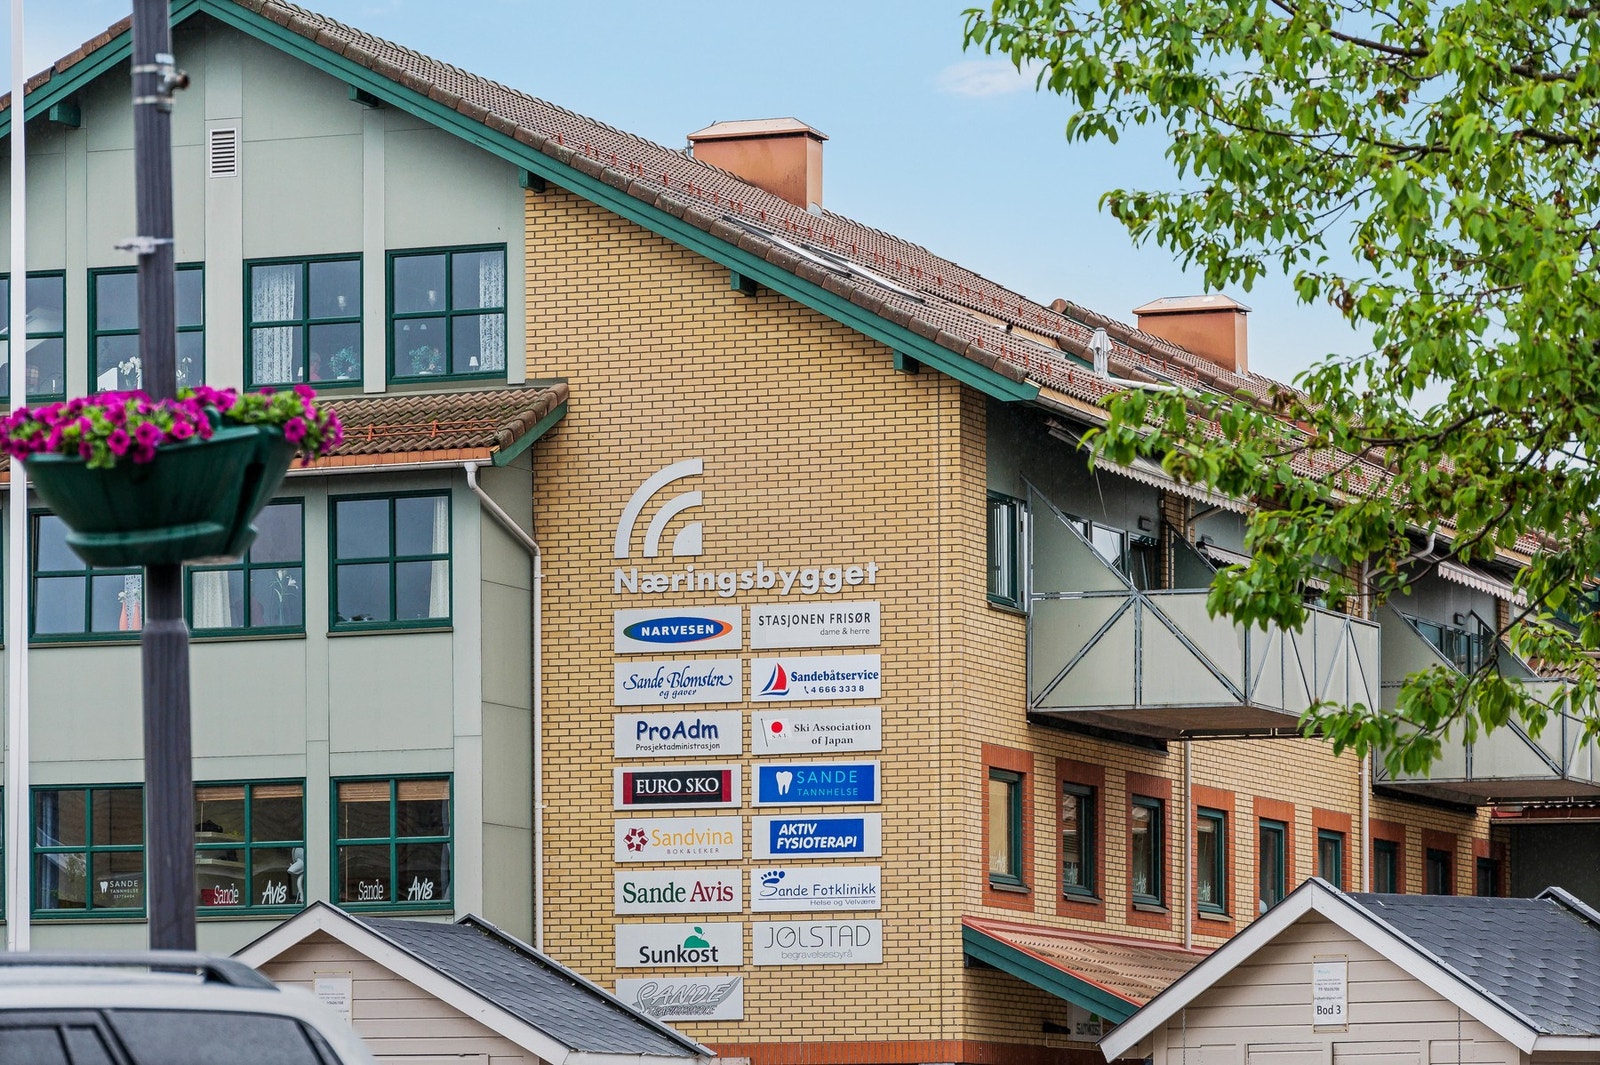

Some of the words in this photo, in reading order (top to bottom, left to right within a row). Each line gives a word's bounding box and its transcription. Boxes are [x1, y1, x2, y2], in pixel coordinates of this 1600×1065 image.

[614, 561, 880, 598] Næringsbygget
[758, 613, 825, 627] STASJONEN
[829, 612, 871, 624] FRISØR
[641, 624, 715, 637] NARVESEN
[820, 628, 841, 636] dame
[842, 627, 848, 635] &
[849, 627, 870, 635] herre
[623, 666, 665, 690] Sande
[666, 665, 734, 689] Blomster
[790, 669, 879, 682] Sandebåtservice
[659, 691, 669, 699] og
[672, 689, 697, 699] gaver
[636, 718, 719, 740] ProAdm
[794, 723, 810, 732] Ski
[812, 722, 871, 732] Association
[635, 742, 721, 752] Prosjektadministrasjon
[811, 736, 822, 744] of
[825, 736, 853, 746] Japan
[797, 770, 858, 784] SANDE
[635, 778, 685, 794] EURO
[686, 777, 719, 793] SKO
[797, 787, 858, 796] TANNHELSE
[778, 823, 817, 835] AKTIV
[651, 828, 734, 847] Sandvina
[777, 836, 857, 849] FYSIOTERAPI
[109, 880, 139, 888] SANDE
[358, 879, 384, 900] Sande
[407, 875, 434, 901] Avis
[760, 878, 809, 897] Sande
[813, 883, 876, 896] Fotklinikk
[213, 883, 239, 904] Sande
[262, 880, 287, 904] Avis
[622, 881, 686, 904] Sande
[690, 881, 734, 902] Avis
[764, 925, 871, 948] JØLSTAD
[639, 945, 719, 964] Sunkost
[781, 949, 853, 960] begravelsesbyrå
[637, 981, 731, 1012] SANDE
[1317, 1005, 1334, 1015] Bod
[1336, 1005, 1342, 1015] 3
